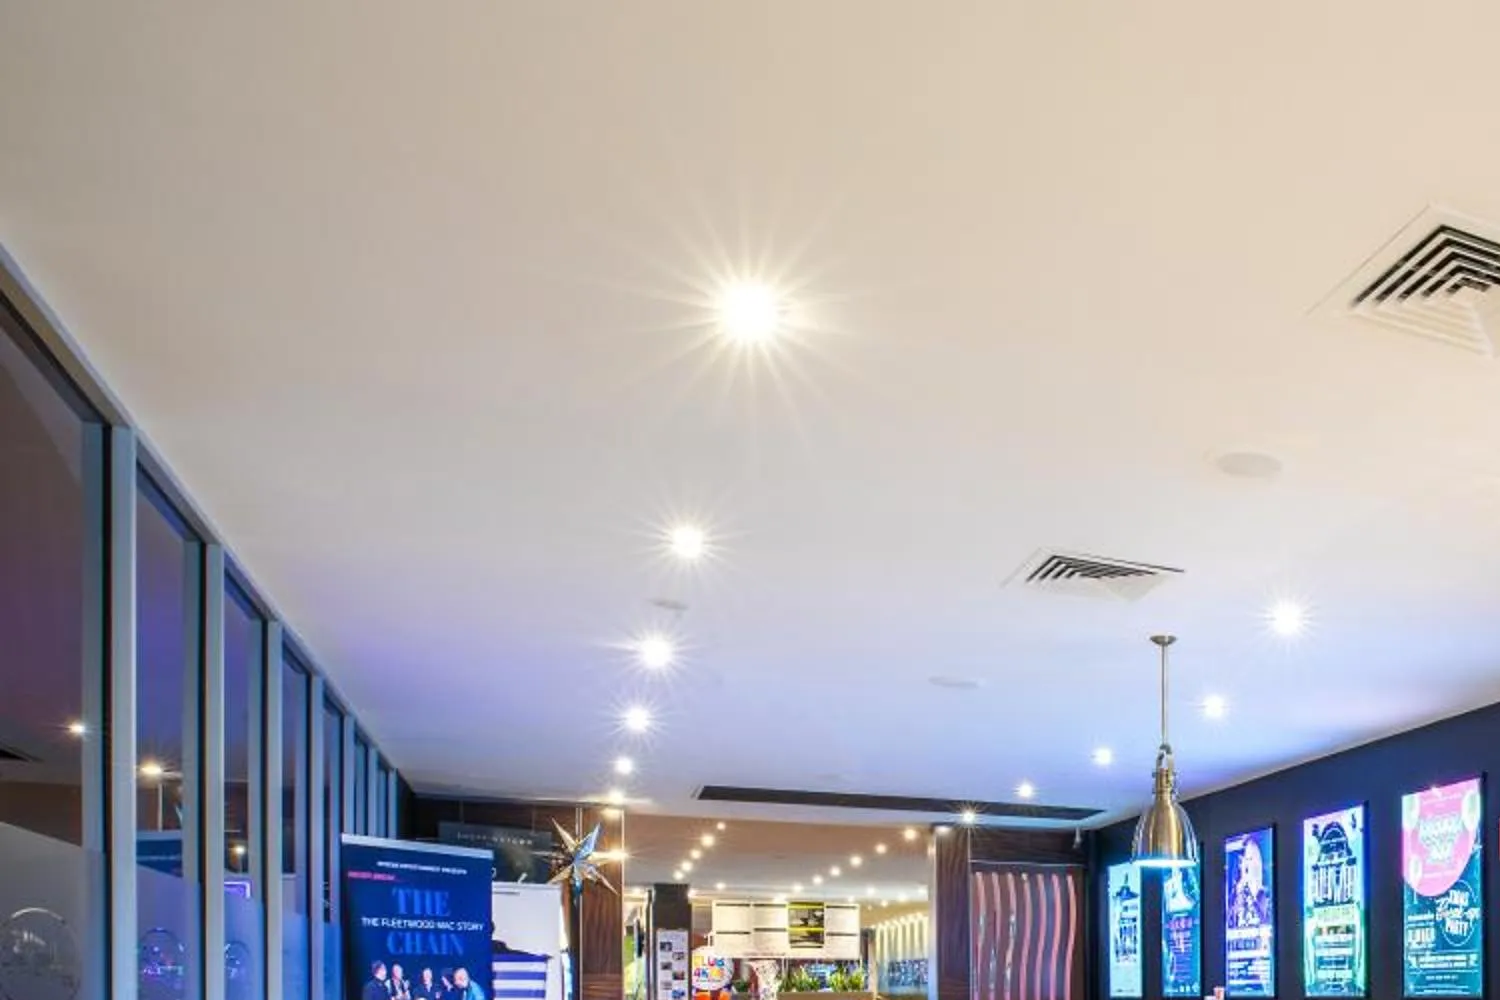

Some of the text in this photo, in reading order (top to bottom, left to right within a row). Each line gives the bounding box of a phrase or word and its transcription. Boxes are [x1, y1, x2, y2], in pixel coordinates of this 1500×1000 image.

[392, 886, 449, 917] THE
[361, 916, 484, 932] THE FLEETWOOD MAC STORY
[386, 931, 464, 956] CHAIN
